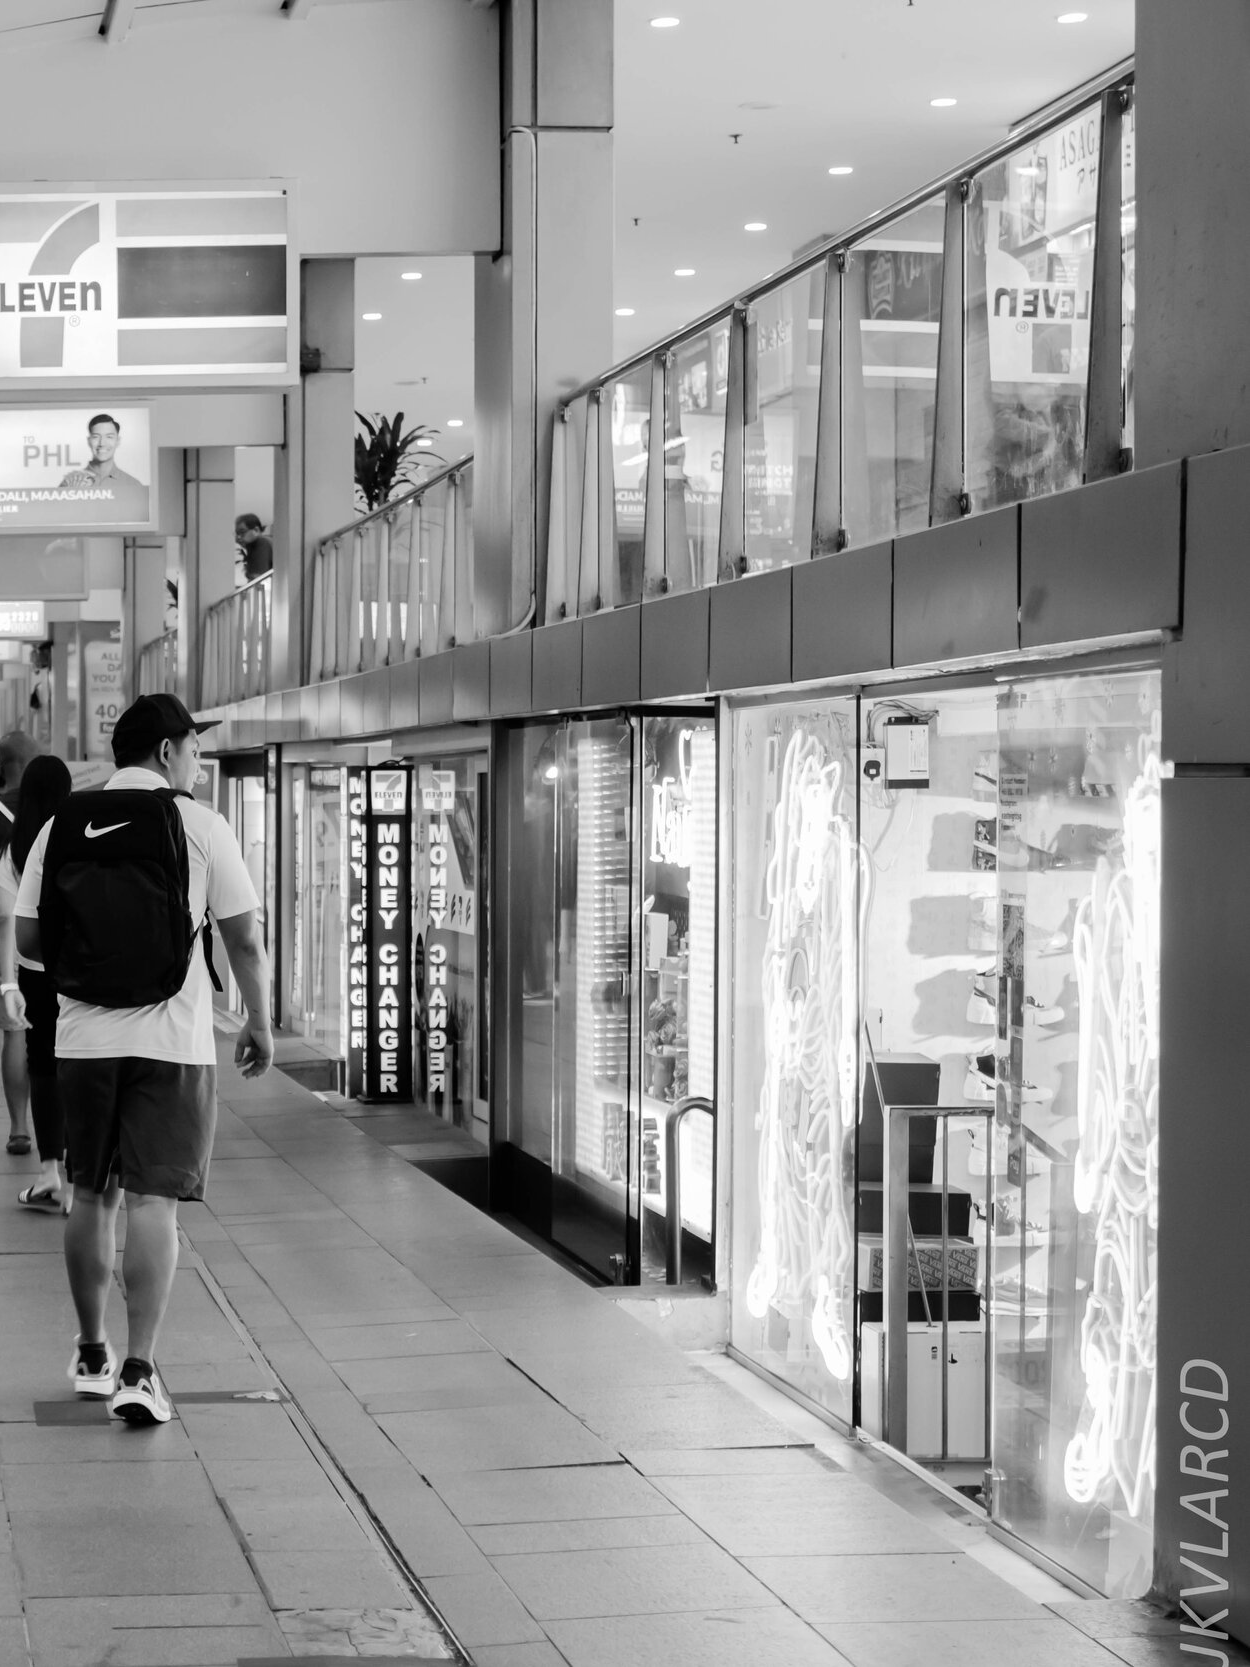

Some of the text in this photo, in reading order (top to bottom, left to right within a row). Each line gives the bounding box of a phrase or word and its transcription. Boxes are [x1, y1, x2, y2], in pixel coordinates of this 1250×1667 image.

[1059, 120, 1099, 171] ASAG
[23, 436, 35, 444] TO
[23, 444, 81, 468] PHL
[31, 489, 115, 500] MAAASAHAN.
[92, 674, 116, 683] YOU
[377, 823, 400, 1093] MONEY CHANGER
